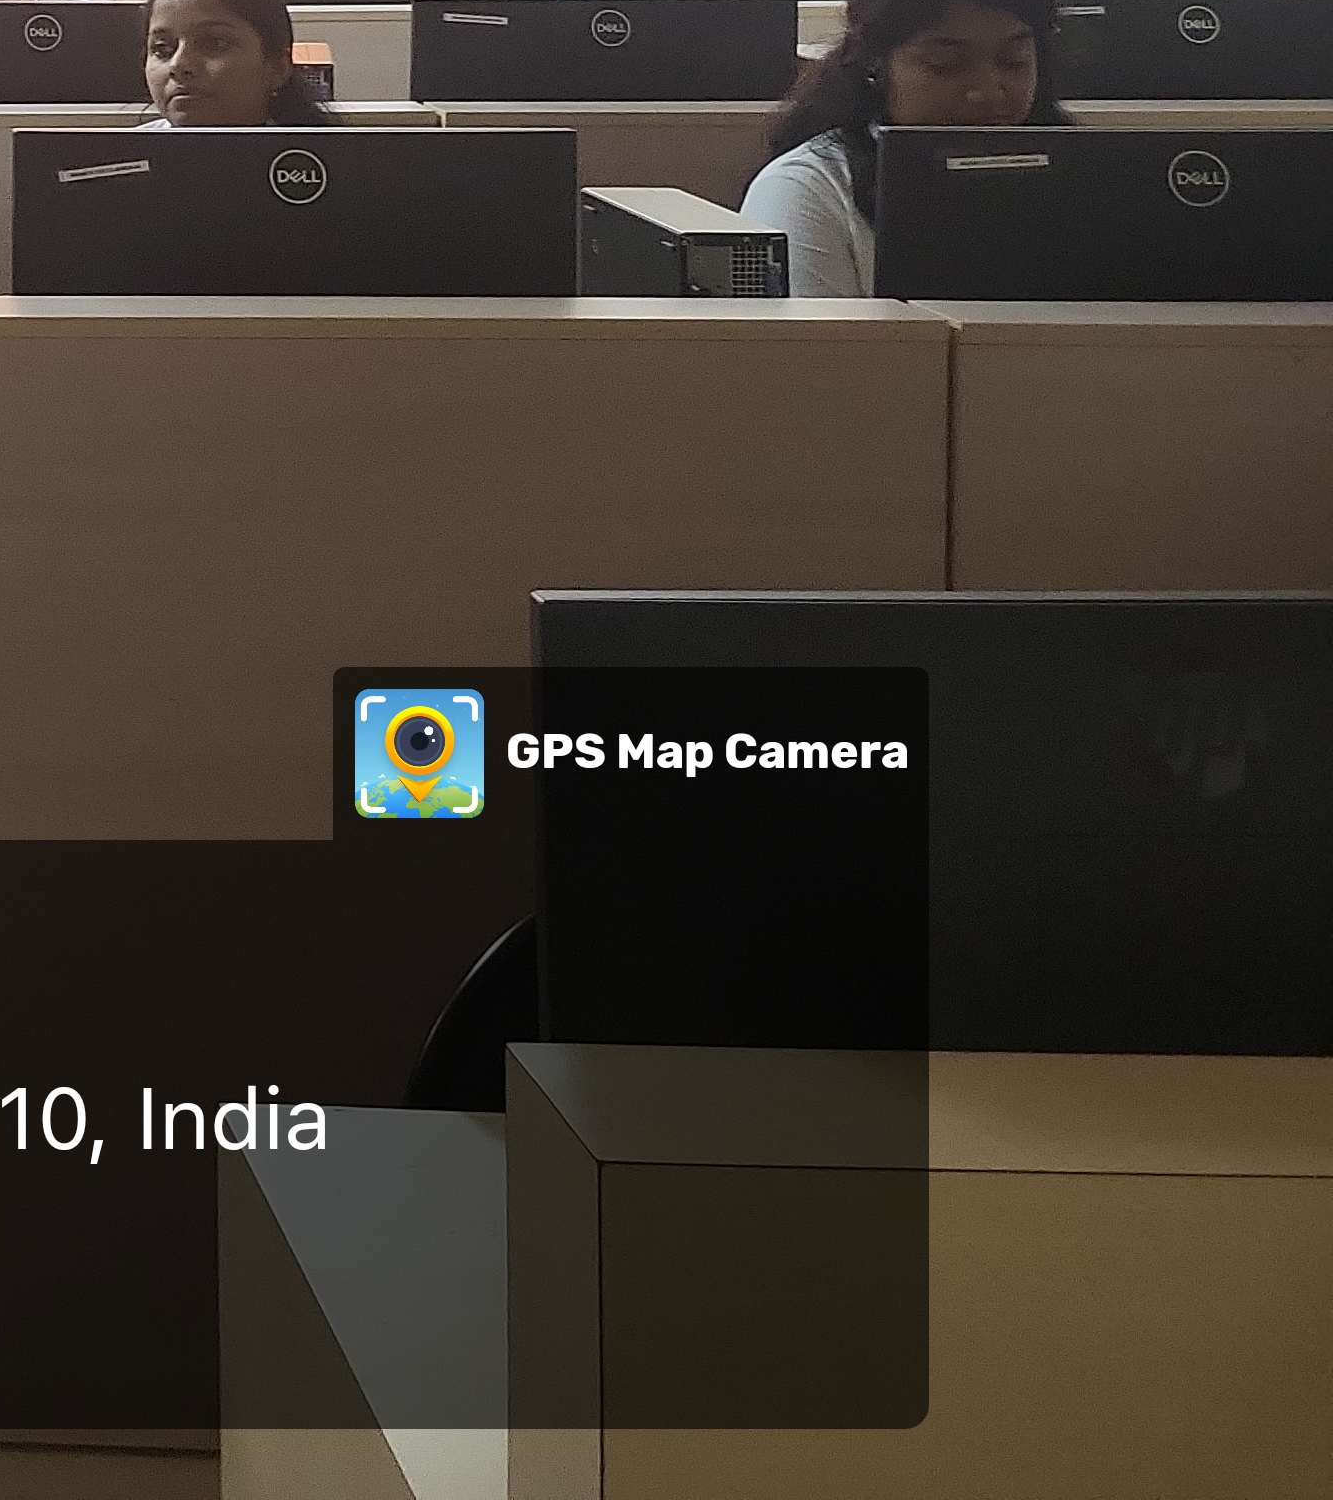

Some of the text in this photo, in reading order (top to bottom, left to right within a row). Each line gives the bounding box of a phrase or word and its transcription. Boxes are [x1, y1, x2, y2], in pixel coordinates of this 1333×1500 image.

[597, 23, 627, 33] DELL
[1184, 19, 1216, 29] DELL
[29, 27, 58, 37] DELL
[276, 169, 322, 184] DELL
[1176, 171, 1224, 186] DELL
